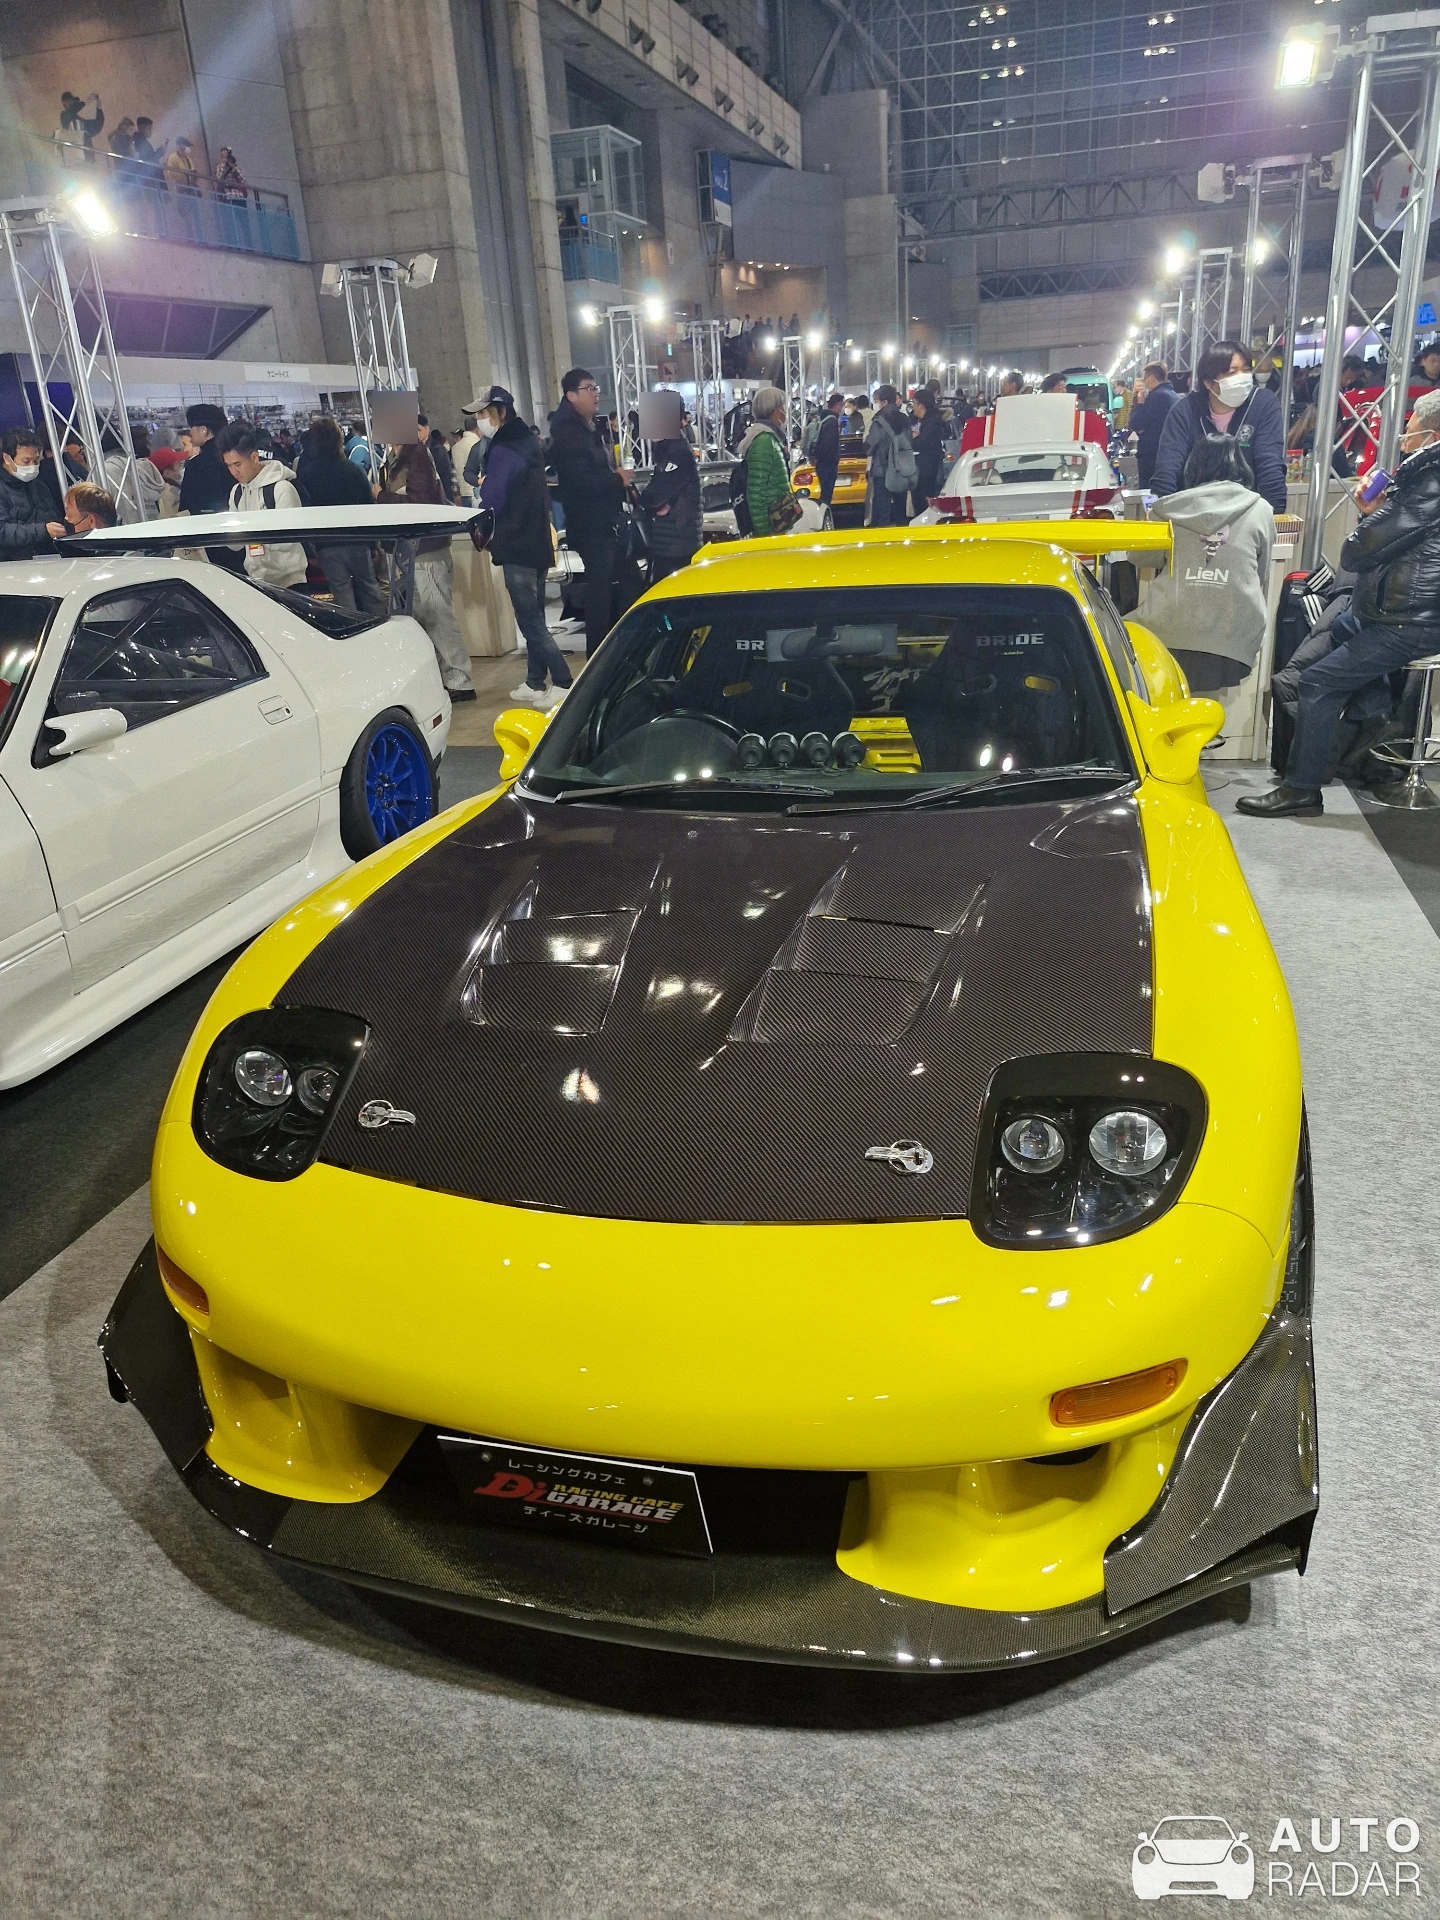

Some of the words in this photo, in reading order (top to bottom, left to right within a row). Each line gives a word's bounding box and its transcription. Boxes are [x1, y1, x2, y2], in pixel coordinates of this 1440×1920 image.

[1185, 566, 1230, 583] LieN
[976, 633, 1045, 647] BRIDE
[508, 1458, 626, 1485] レーシングカフェ
[546, 1491, 680, 1521] GARAGE
[553, 1484, 627, 1502] RACING
[631, 1496, 685, 1512] CAFE
[523, 1505, 649, 1533] ディーズガレージ
